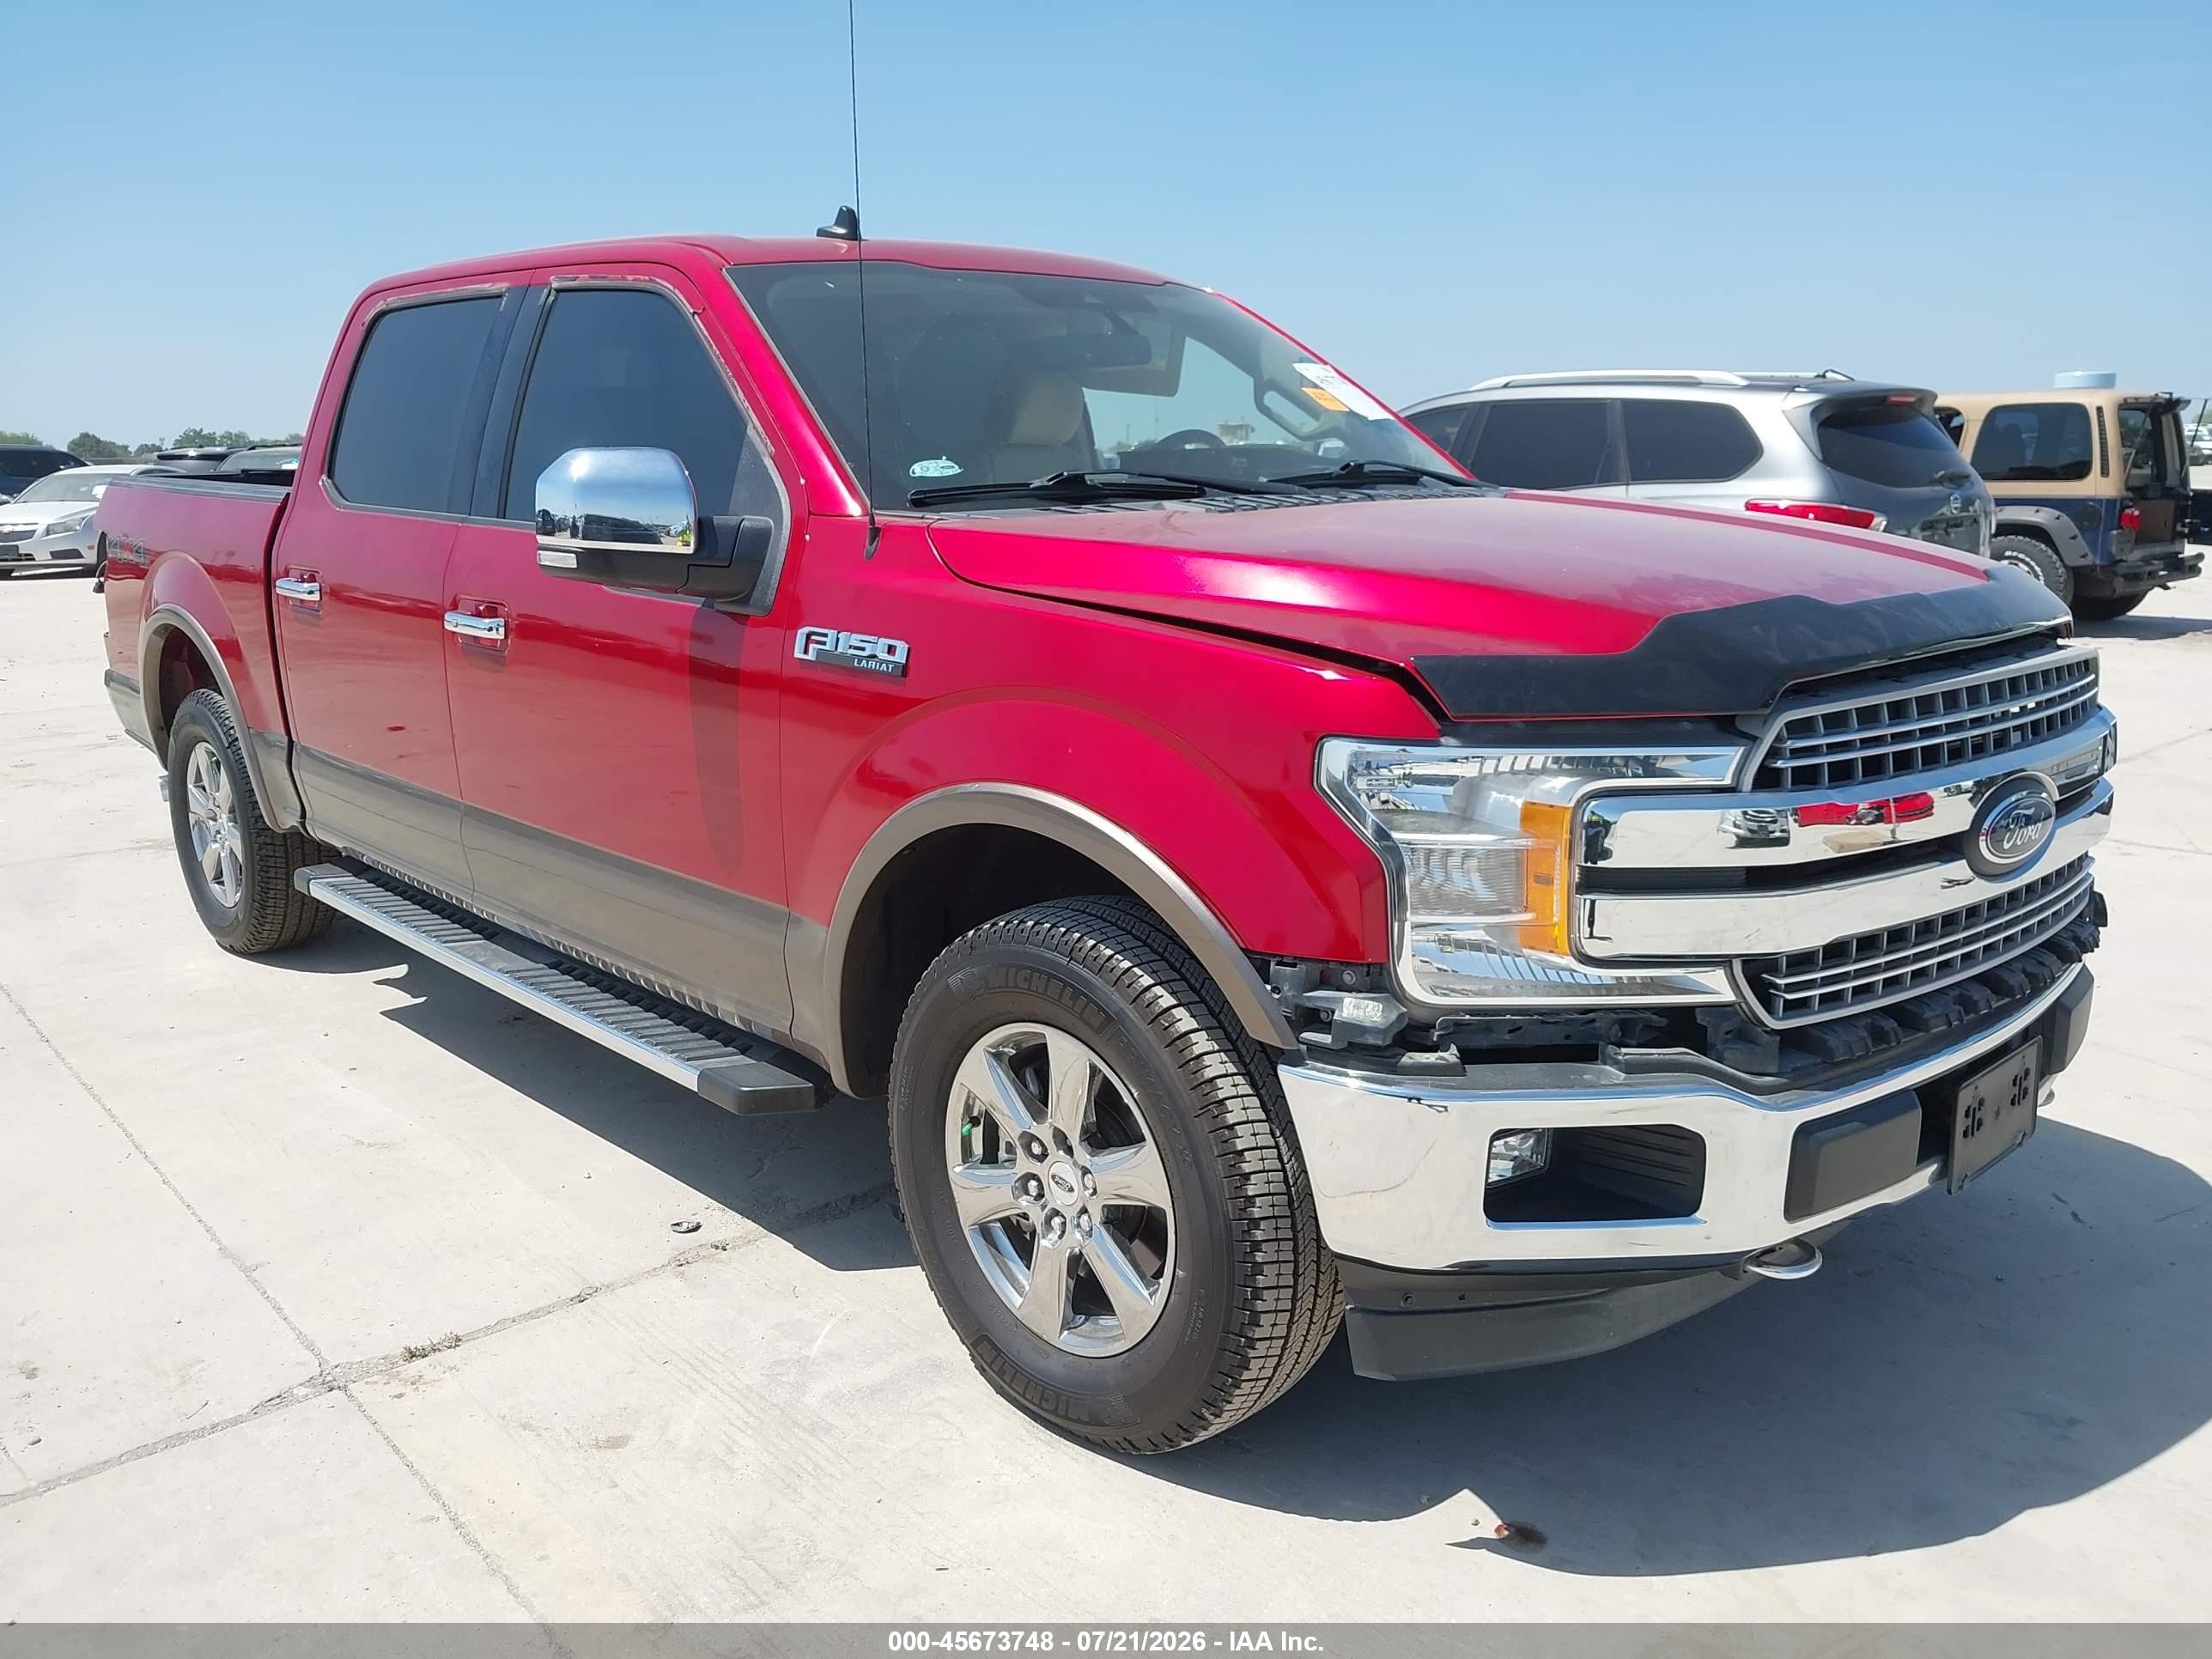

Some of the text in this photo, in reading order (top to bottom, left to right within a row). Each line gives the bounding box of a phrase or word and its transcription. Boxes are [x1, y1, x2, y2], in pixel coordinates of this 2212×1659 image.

[854, 658, 895, 672] LARIAT
[2003, 806, 2045, 849] Ford
[990, 967, 1107, 1028] MICHELIN
[975, 1340, 1090, 1422] MICHELIN
